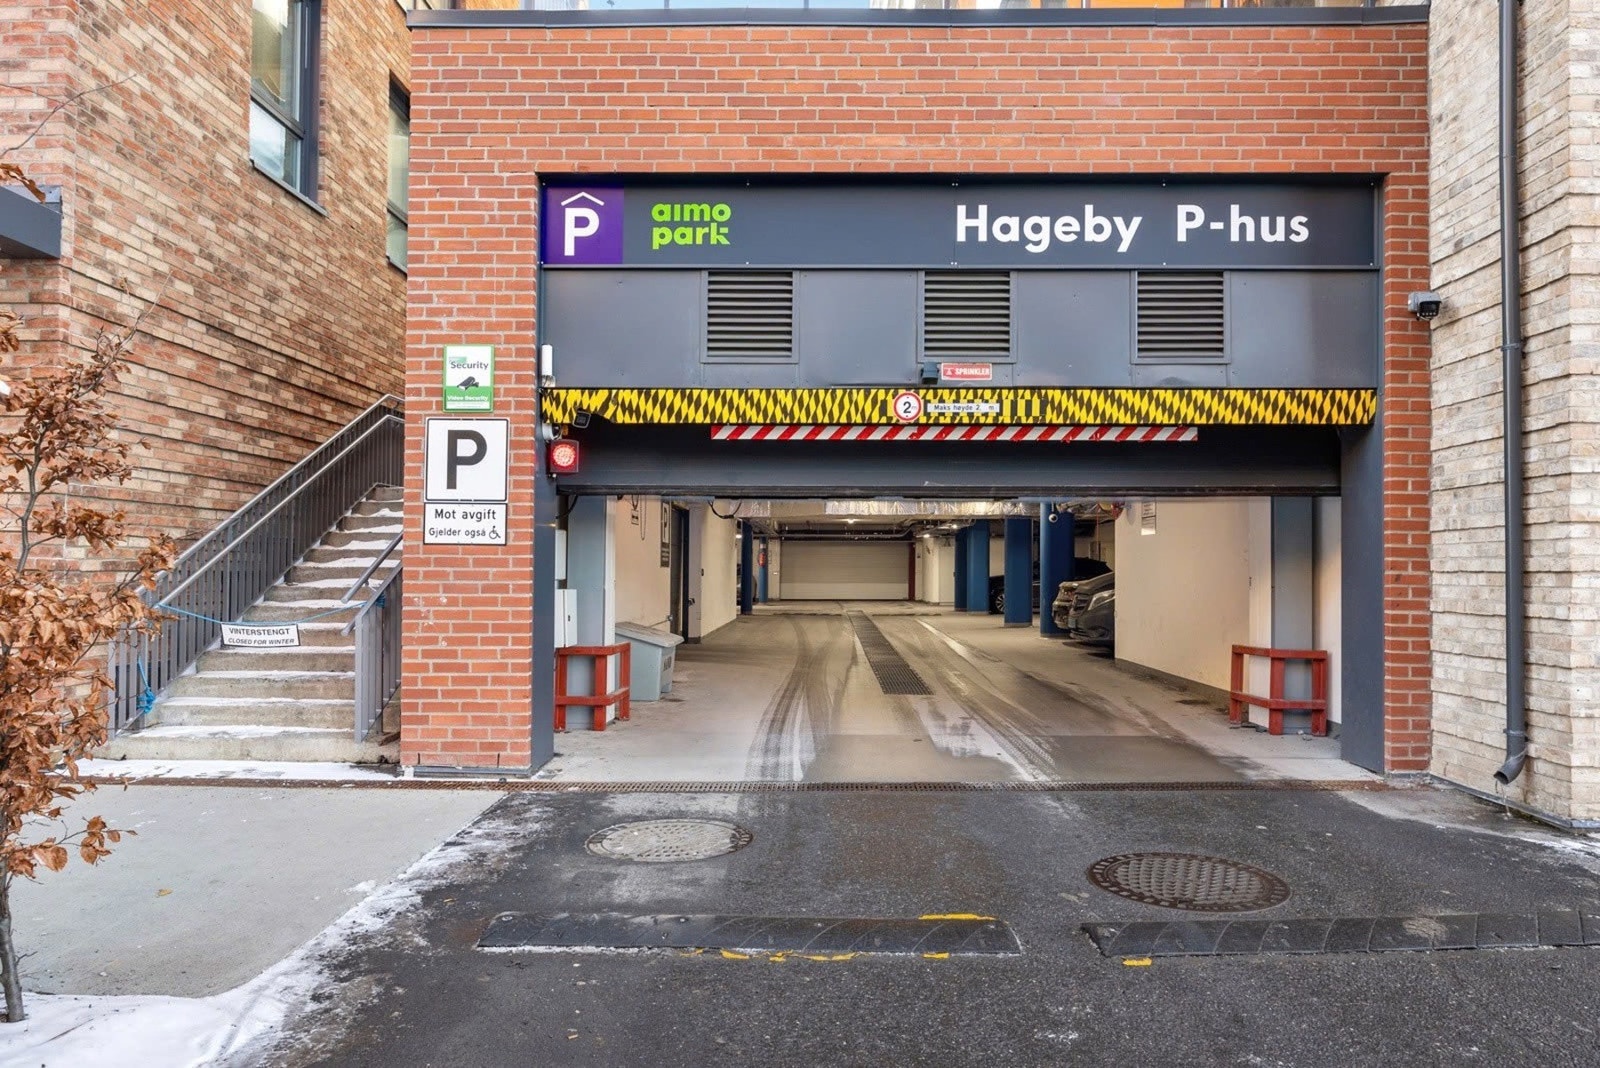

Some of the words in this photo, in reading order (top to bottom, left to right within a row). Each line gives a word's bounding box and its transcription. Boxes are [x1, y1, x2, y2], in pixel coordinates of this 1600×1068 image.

[651, 203, 732, 222] aimo
[564, 207, 600, 256] P
[956, 204, 1143, 253] Hageby
[1177, 204, 1310, 242] P-hus
[652, 222, 730, 250] park
[450, 361, 489, 371] Security
[955, 367, 990, 376] SPRINKLER
[903, 401, 911, 413] 2
[953, 404, 973, 412] høyde
[446, 429, 488, 490] P
[434, 508, 457, 520] Mot
[461, 508, 497, 523] avgift
[428, 527, 462, 539] Gjelder
[464, 527, 487, 539] også
[229, 627, 290, 636] VINTERSTENGT
[228, 637, 253, 645] CLOSED
